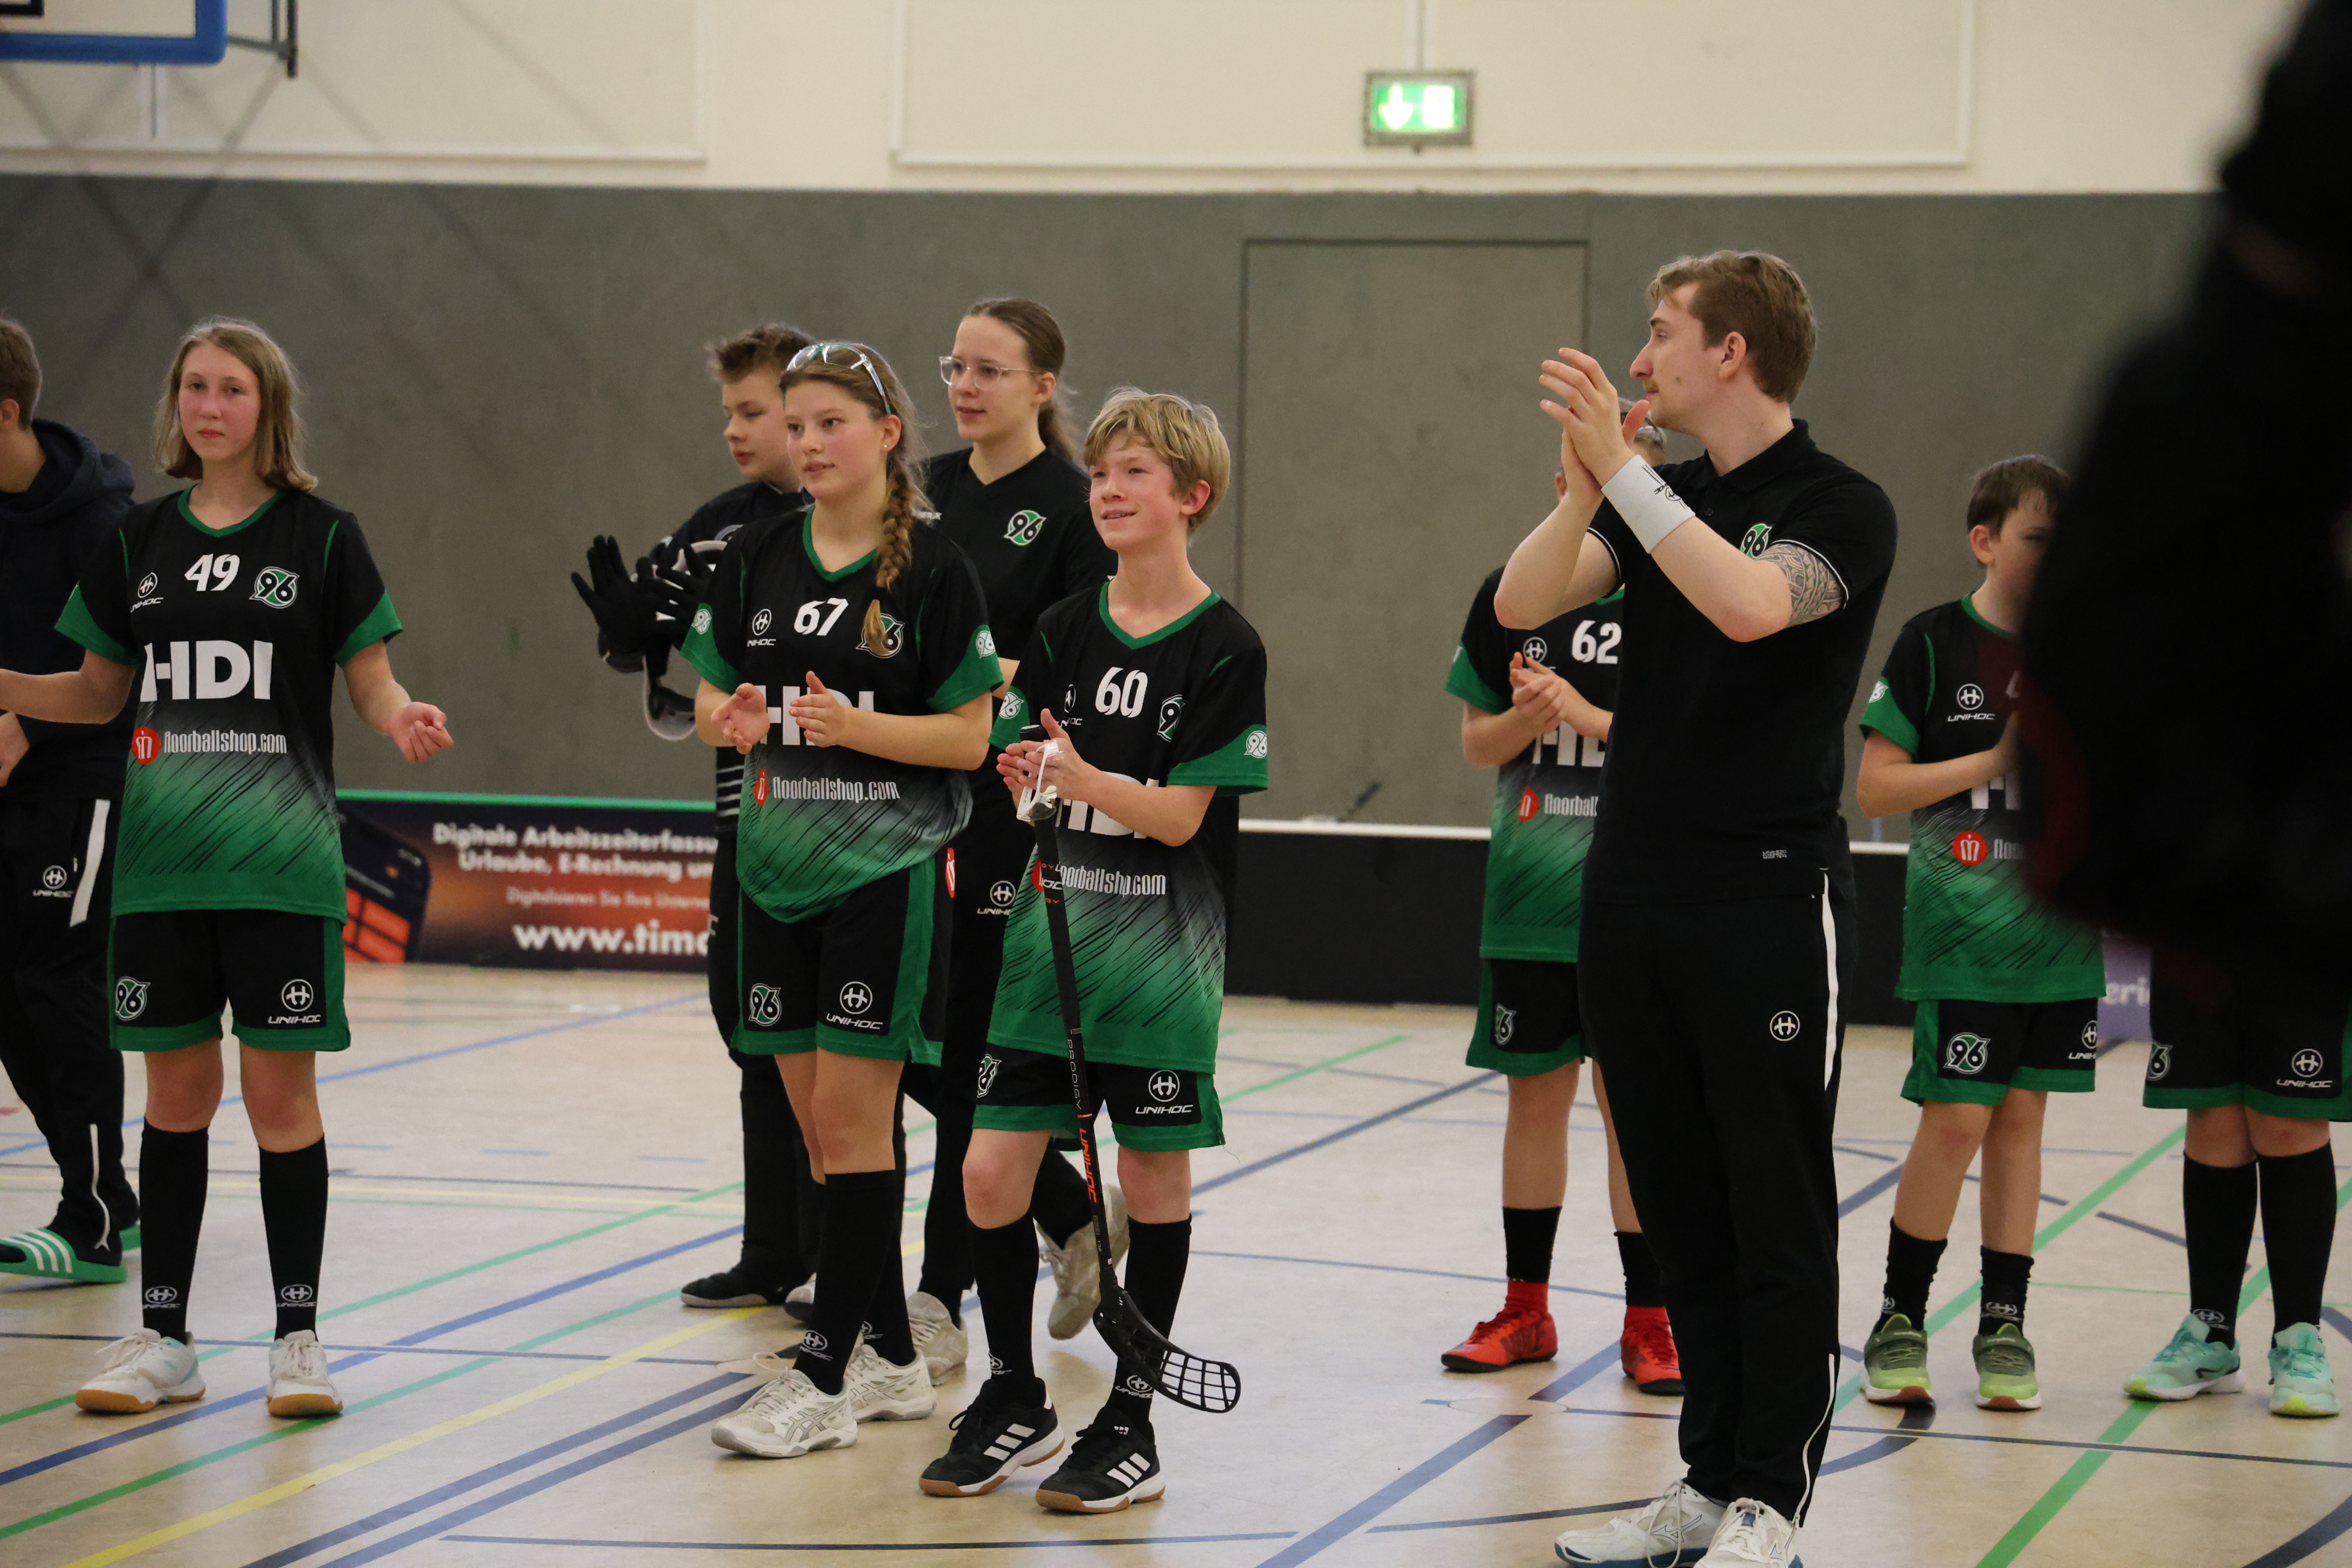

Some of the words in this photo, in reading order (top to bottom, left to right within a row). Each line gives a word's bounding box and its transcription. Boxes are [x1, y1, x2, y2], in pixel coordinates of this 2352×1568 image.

[1005, 513, 1044, 543] 96
[1742, 526, 1771, 557] 96
[184, 553, 240, 592] 49
[255, 570, 297, 603] 96
[794, 598, 849, 636] 67
[747, 638, 777, 647] NIHOC
[1572, 619, 1622, 664] 62
[140, 640, 273, 702] HDI
[1095, 666, 1148, 718] 60
[1158, 700, 1181, 734] 9
[1947, 713, 1996, 722] UNIHOC
[164, 730, 287, 754] floorballshop.com
[772, 777, 900, 800] floorballshop.com
[433, 822, 518, 852] Digitale
[268, 1014, 321, 1025] UNIHOC
[751, 987, 779, 1021] 96
[826, 1013, 883, 1030] UNIHOC
[1948, 1038, 1987, 1069] 96
[1067, 1039, 1082, 1110] PRODIGY
[2276, 1078, 2333, 1089] UNIHOC
[1135, 1104, 1194, 1114] UNIHOC
[1079, 1127, 1098, 1203] UNIHOC
